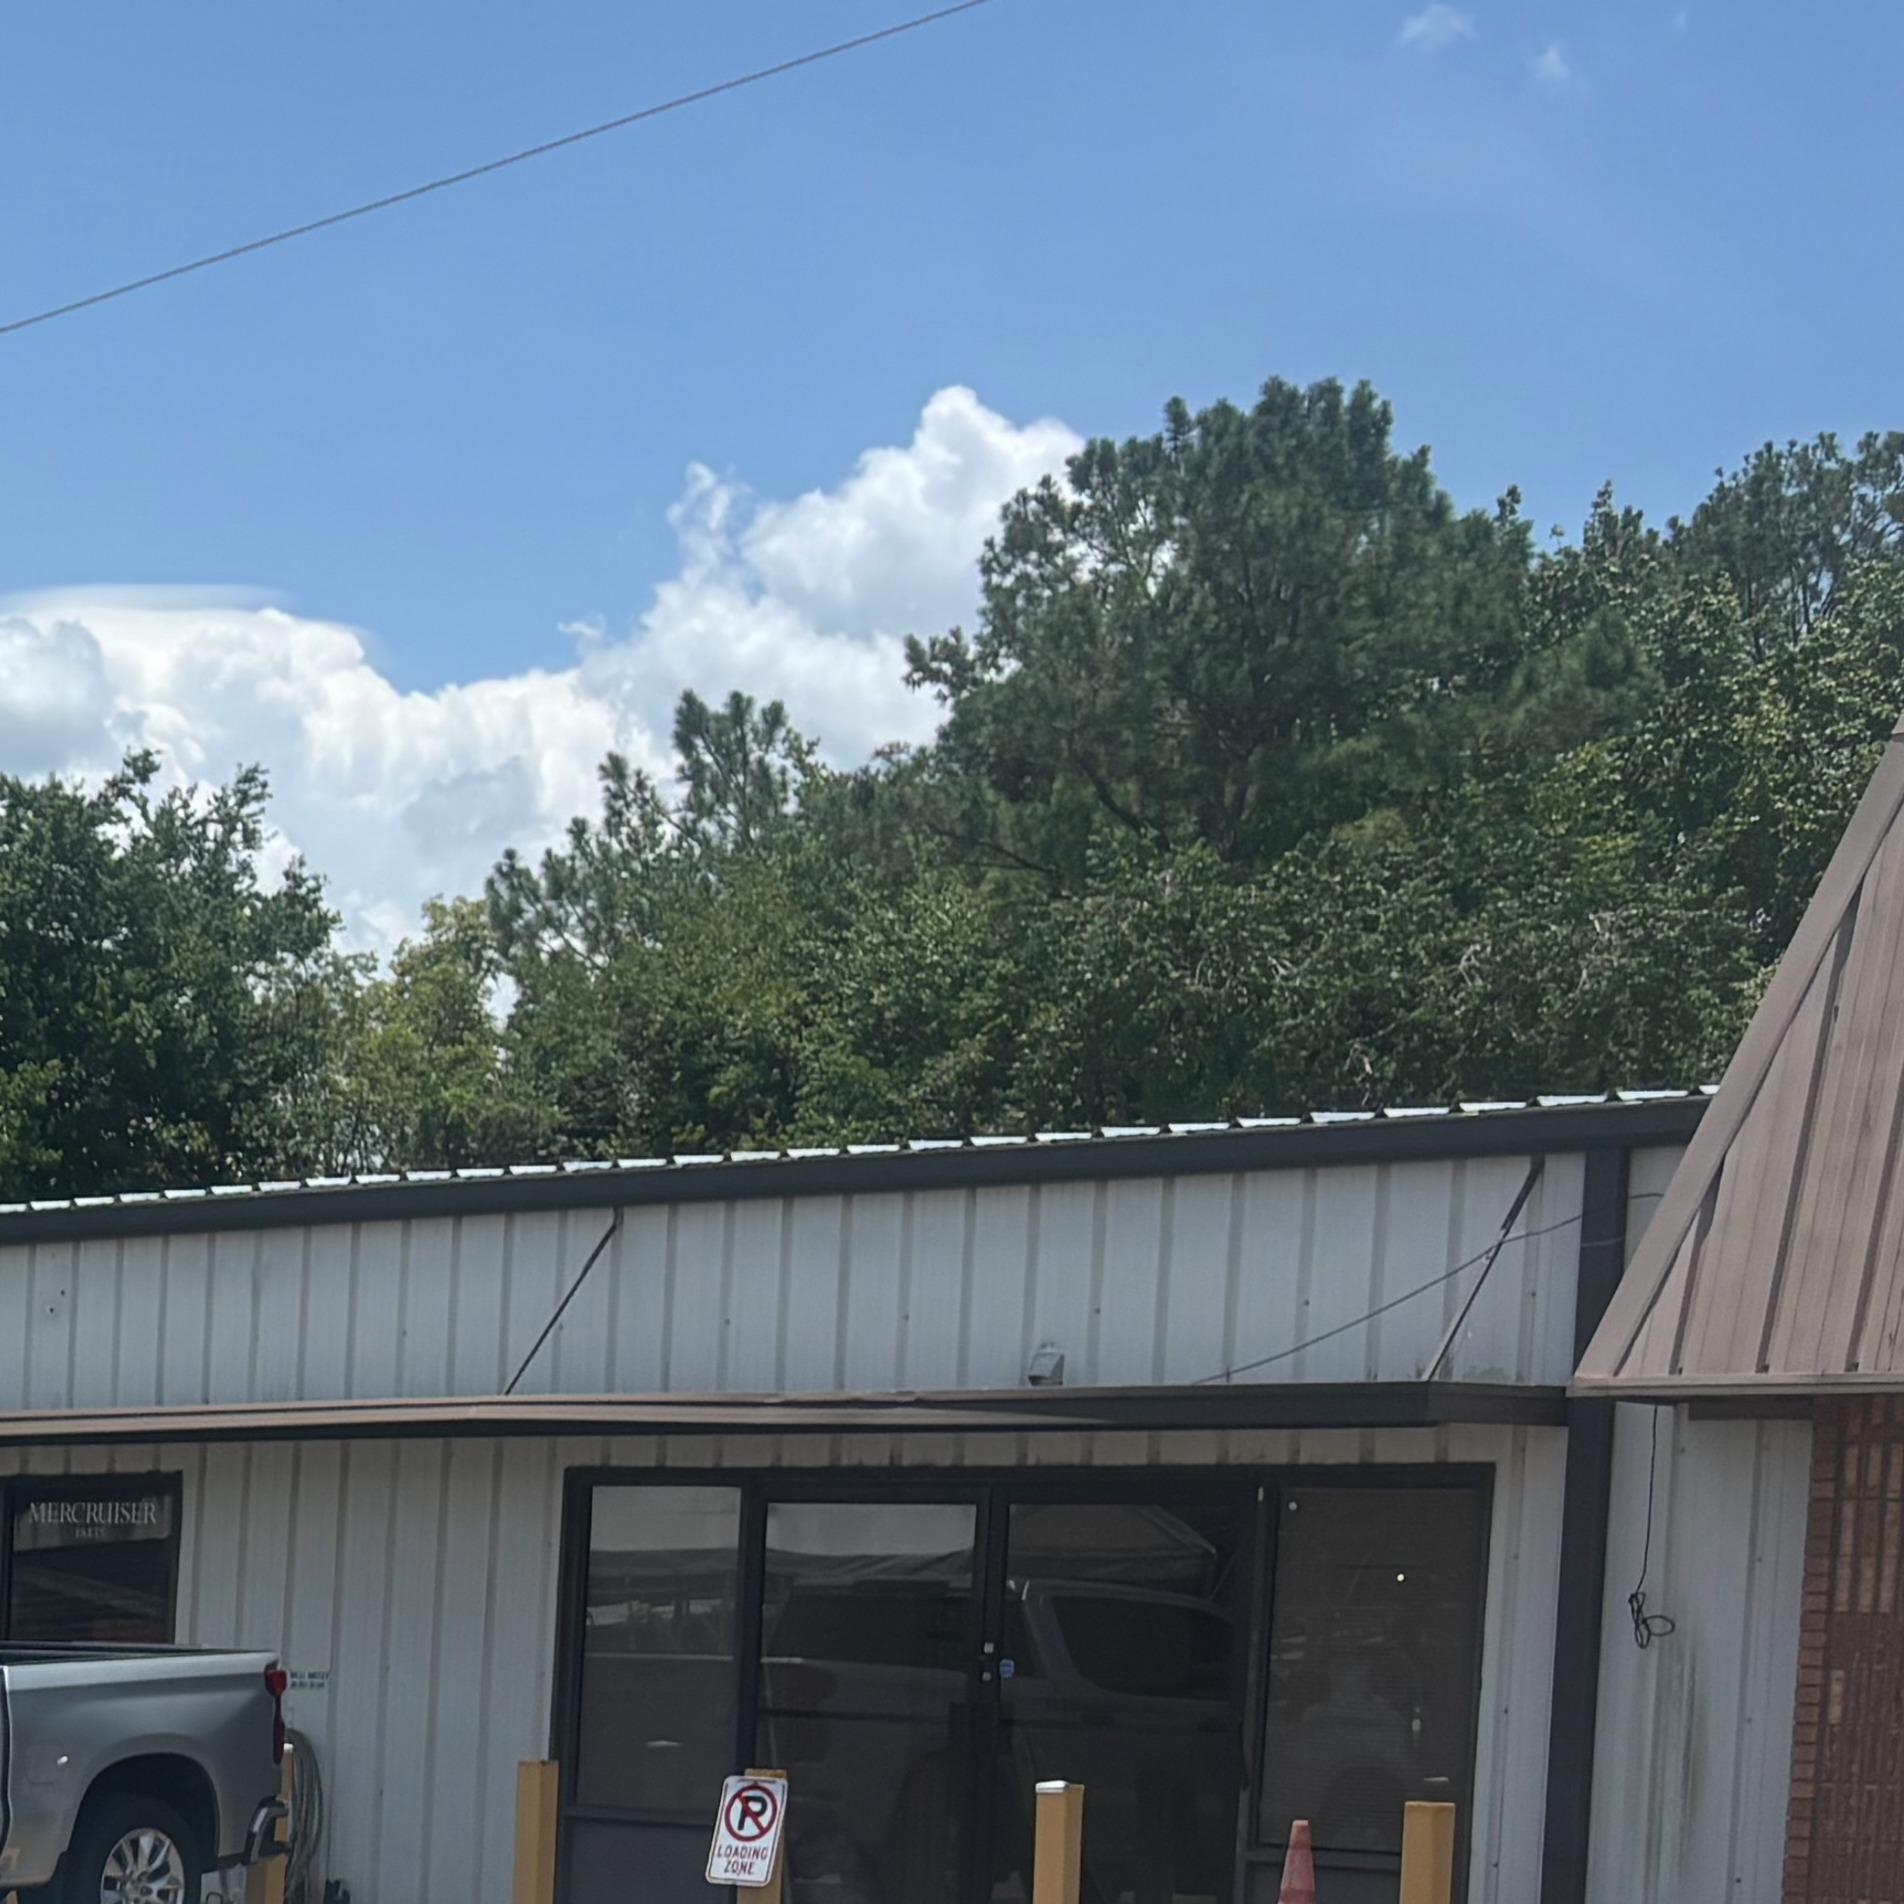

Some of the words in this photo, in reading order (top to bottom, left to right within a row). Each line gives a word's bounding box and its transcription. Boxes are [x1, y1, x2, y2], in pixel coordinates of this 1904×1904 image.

[30, 1501, 157, 1524] MERCRUISER
[717, 1844, 769, 1860] LOADING
[724, 1861, 756, 1876] ZONE
